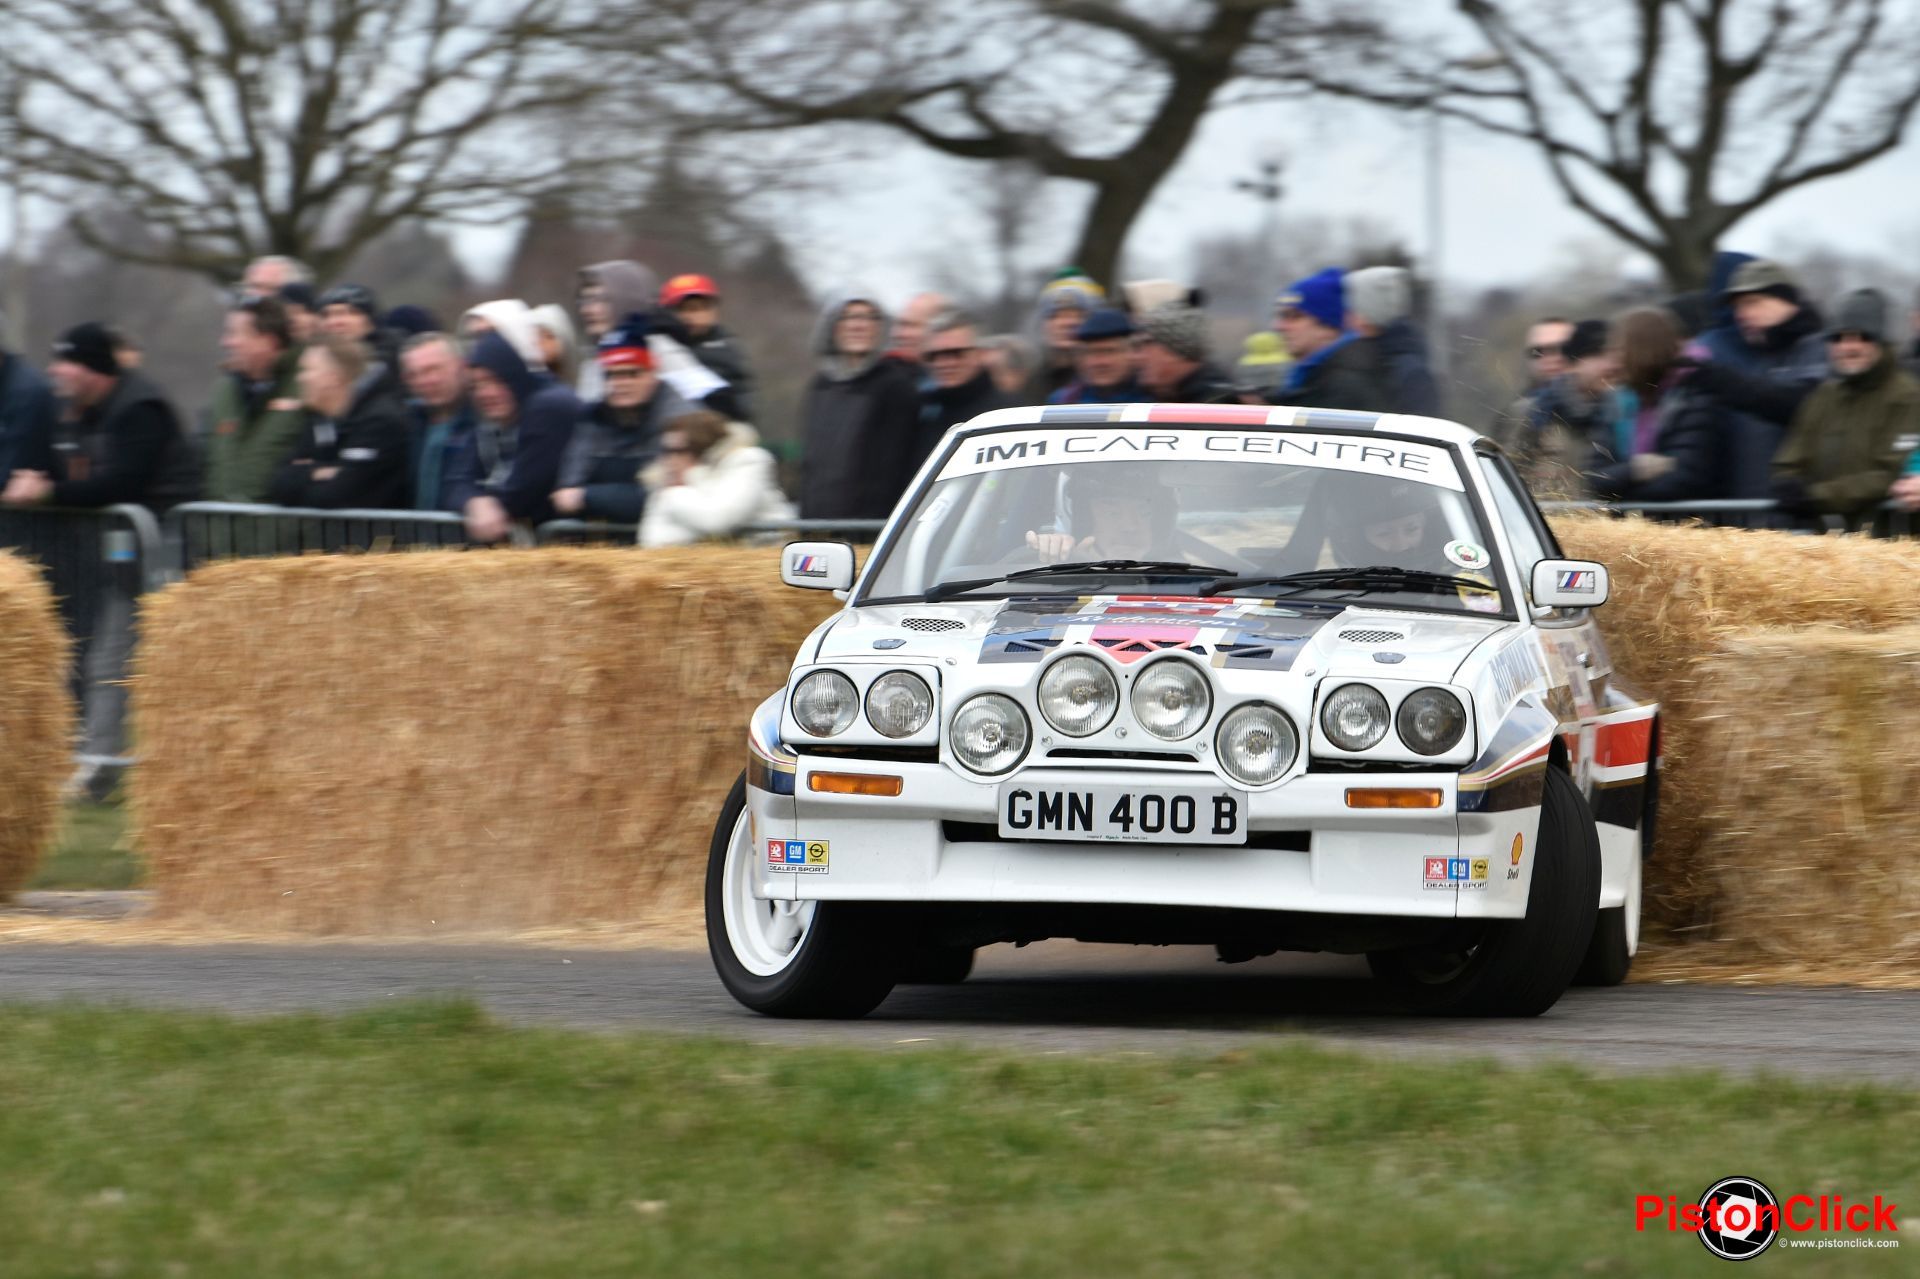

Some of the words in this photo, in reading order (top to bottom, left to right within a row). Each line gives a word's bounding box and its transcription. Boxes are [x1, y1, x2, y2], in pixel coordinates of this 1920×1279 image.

[975, 440, 1047, 464] iM1
[1064, 435, 1180, 453] CAR
[1205, 436, 1431, 473] CENTRE
[1008, 790, 1093, 831] GMN
[1108, 793, 1195, 834] 400
[1212, 795, 1238, 835] B
[789, 845, 802, 856] GM
